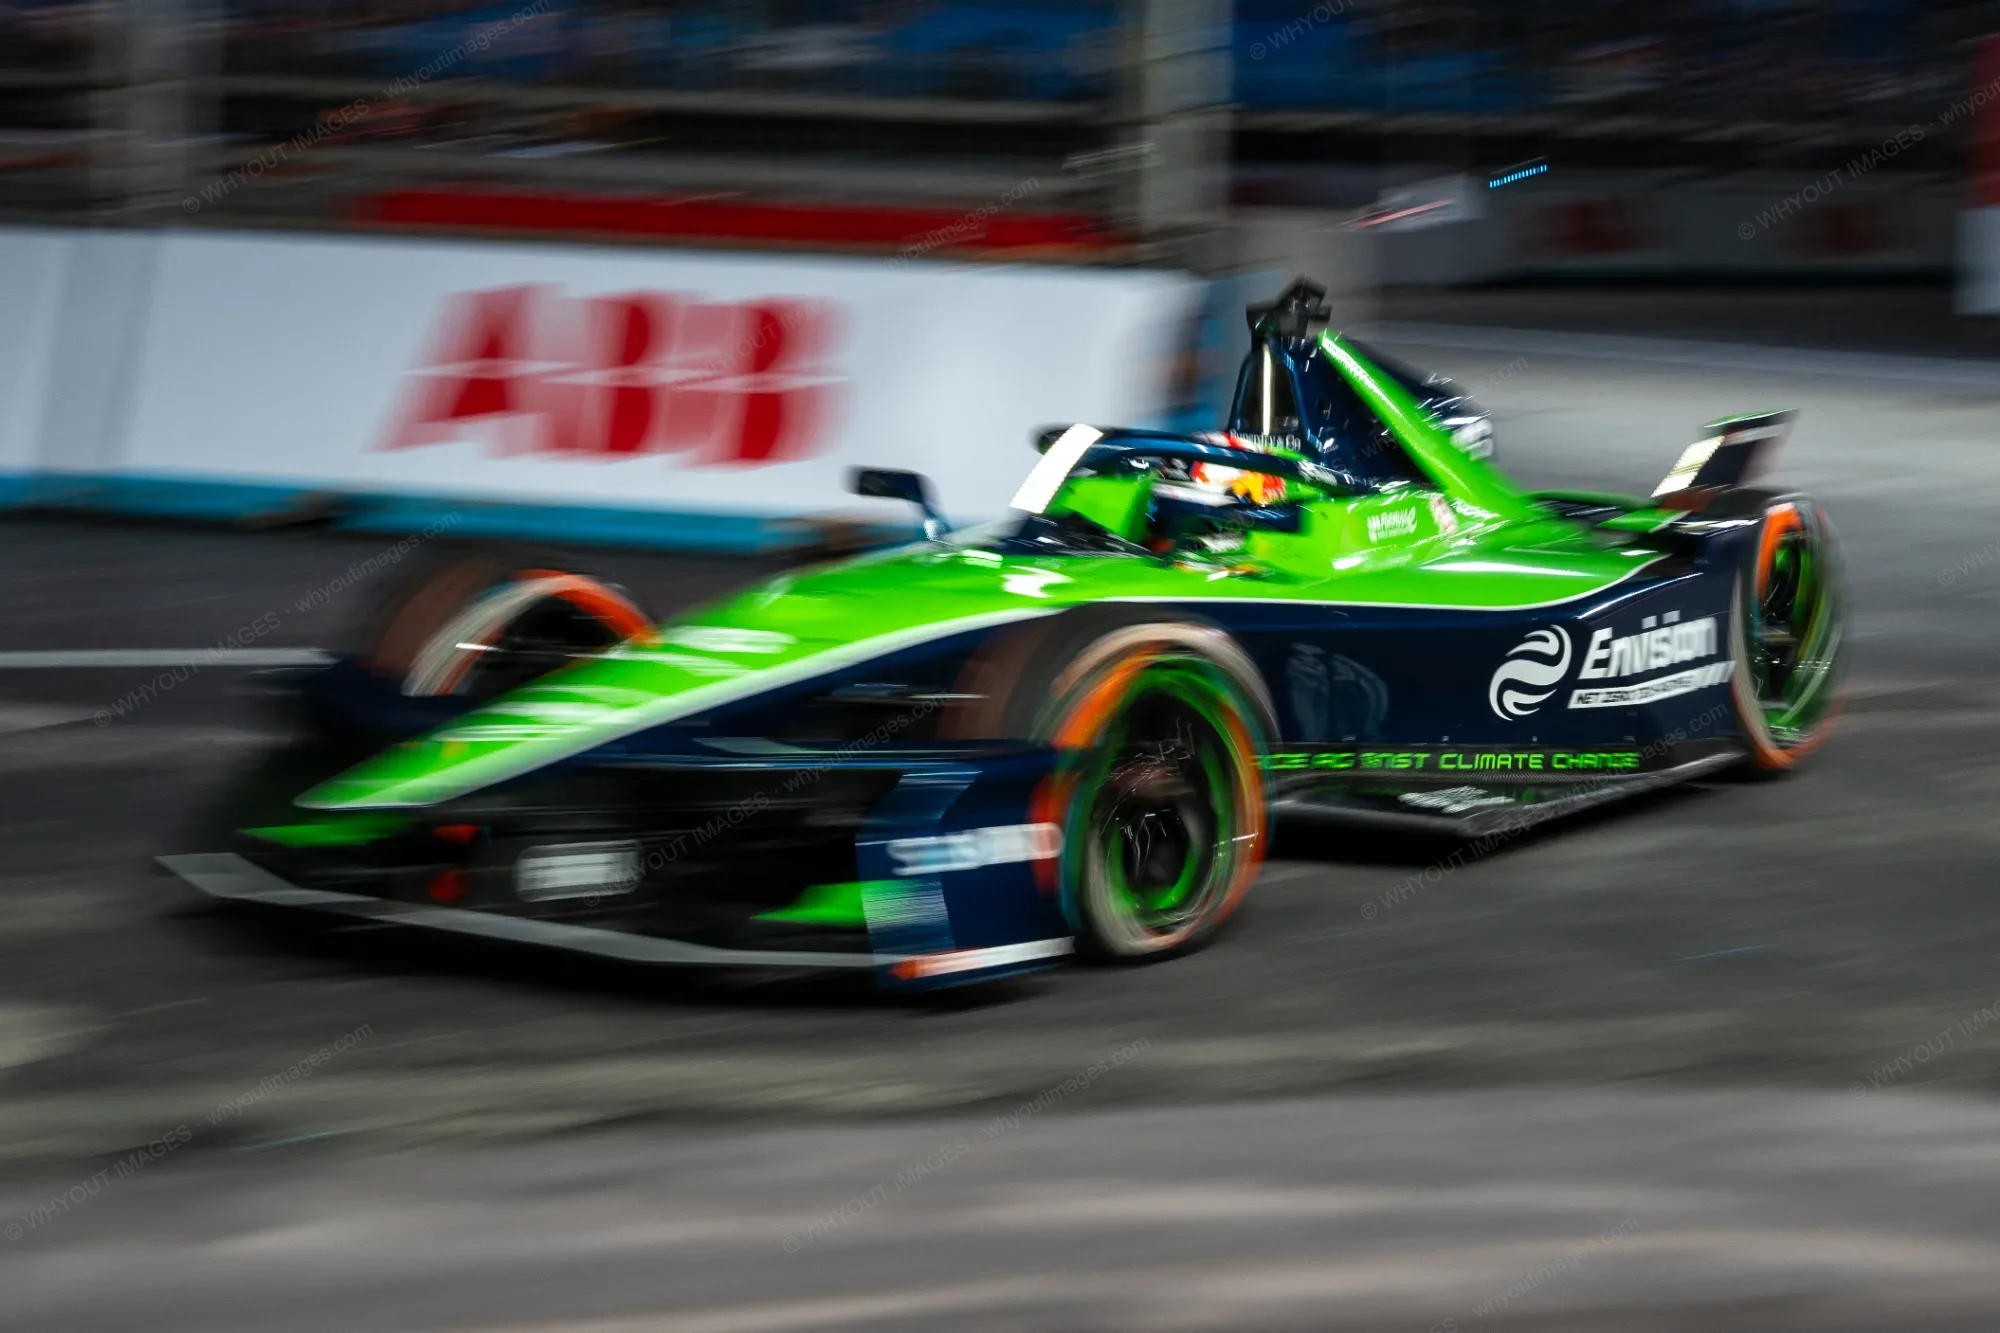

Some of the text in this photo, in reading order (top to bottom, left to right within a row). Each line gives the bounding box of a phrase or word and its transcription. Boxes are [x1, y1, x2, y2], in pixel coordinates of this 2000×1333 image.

[368, 281, 854, 472] ABB
[1577, 610, 1717, 680] Envision
[1439, 753, 1544, 770] CLIMATE
